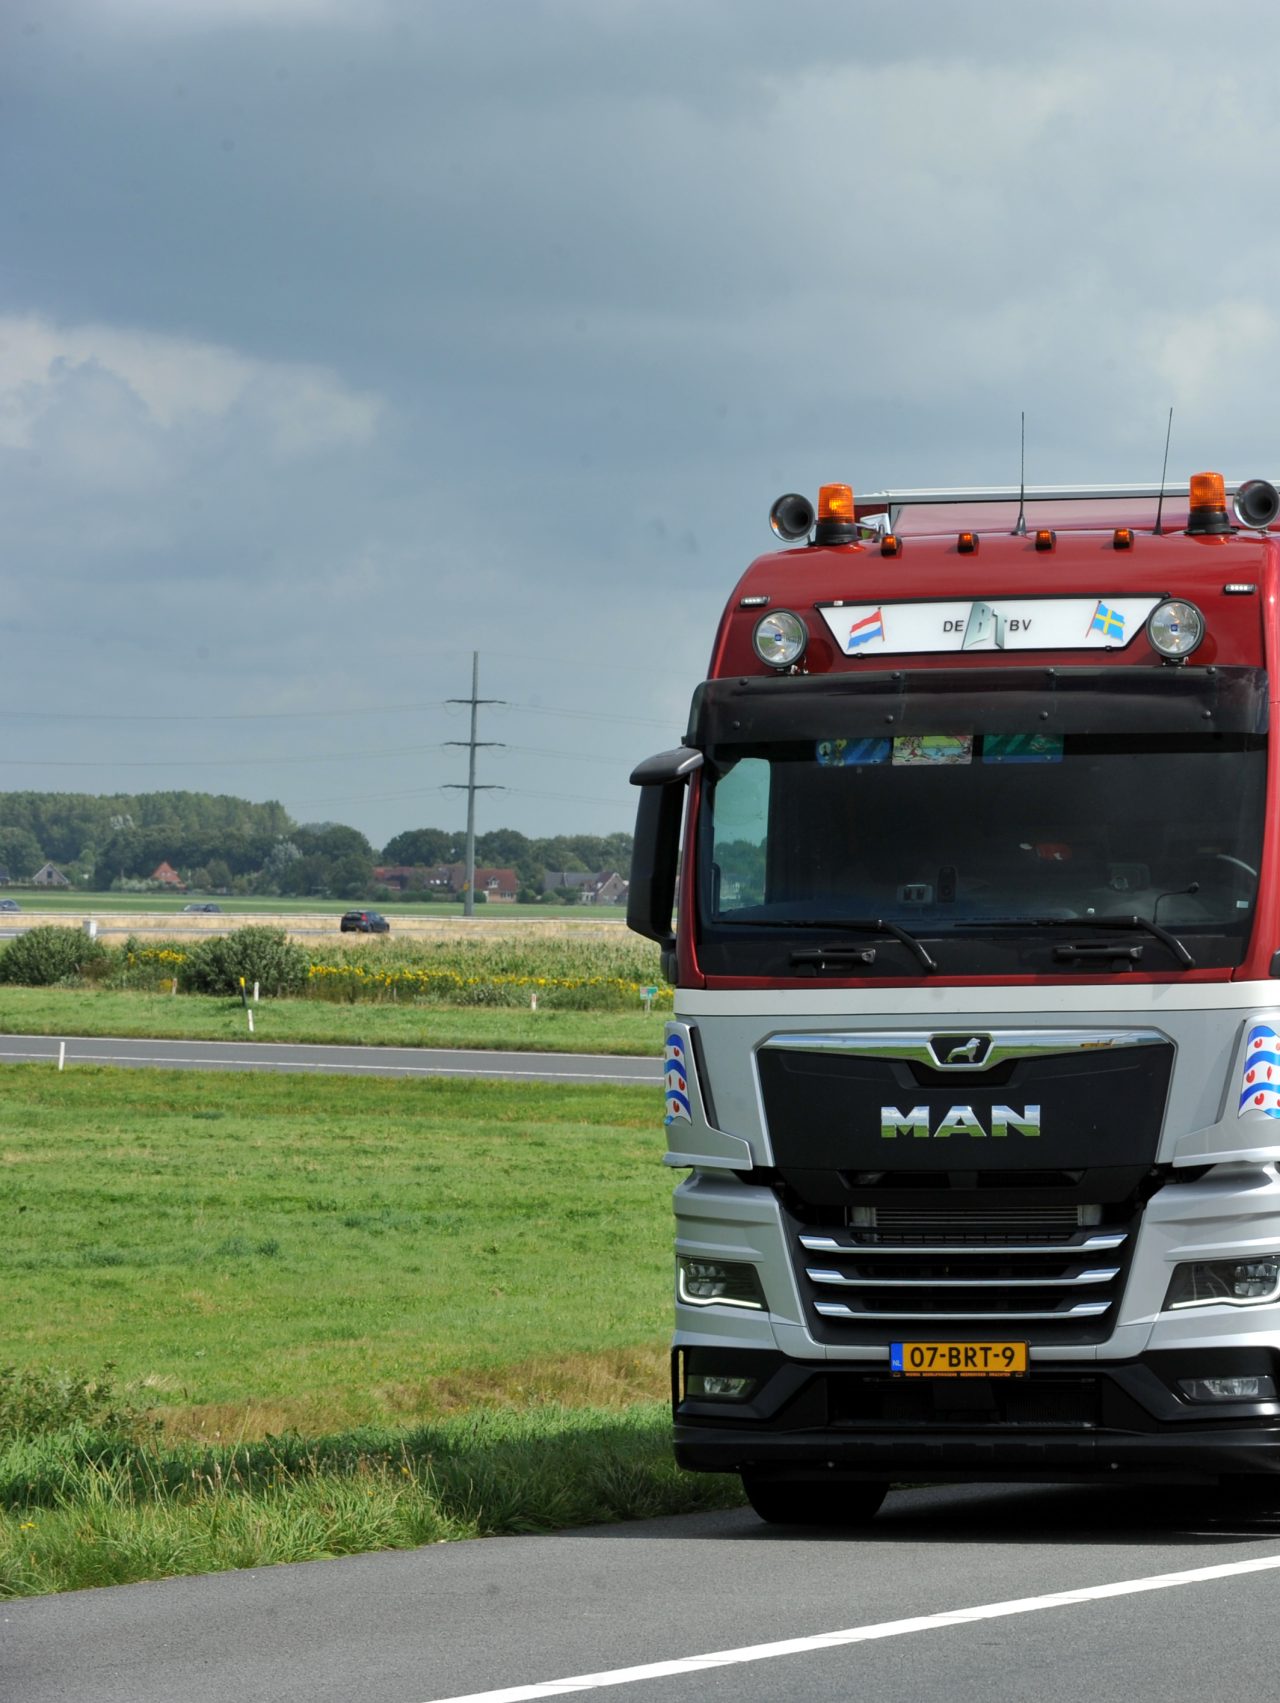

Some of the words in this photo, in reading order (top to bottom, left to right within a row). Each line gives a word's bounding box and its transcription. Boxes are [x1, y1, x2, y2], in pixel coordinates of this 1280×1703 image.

[943, 620, 965, 632] DE
[881, 1105, 1041, 1138] MAN
[892, 1359, 902, 1367] NL
[910, 1346, 1015, 1368] 07-BRT-9
